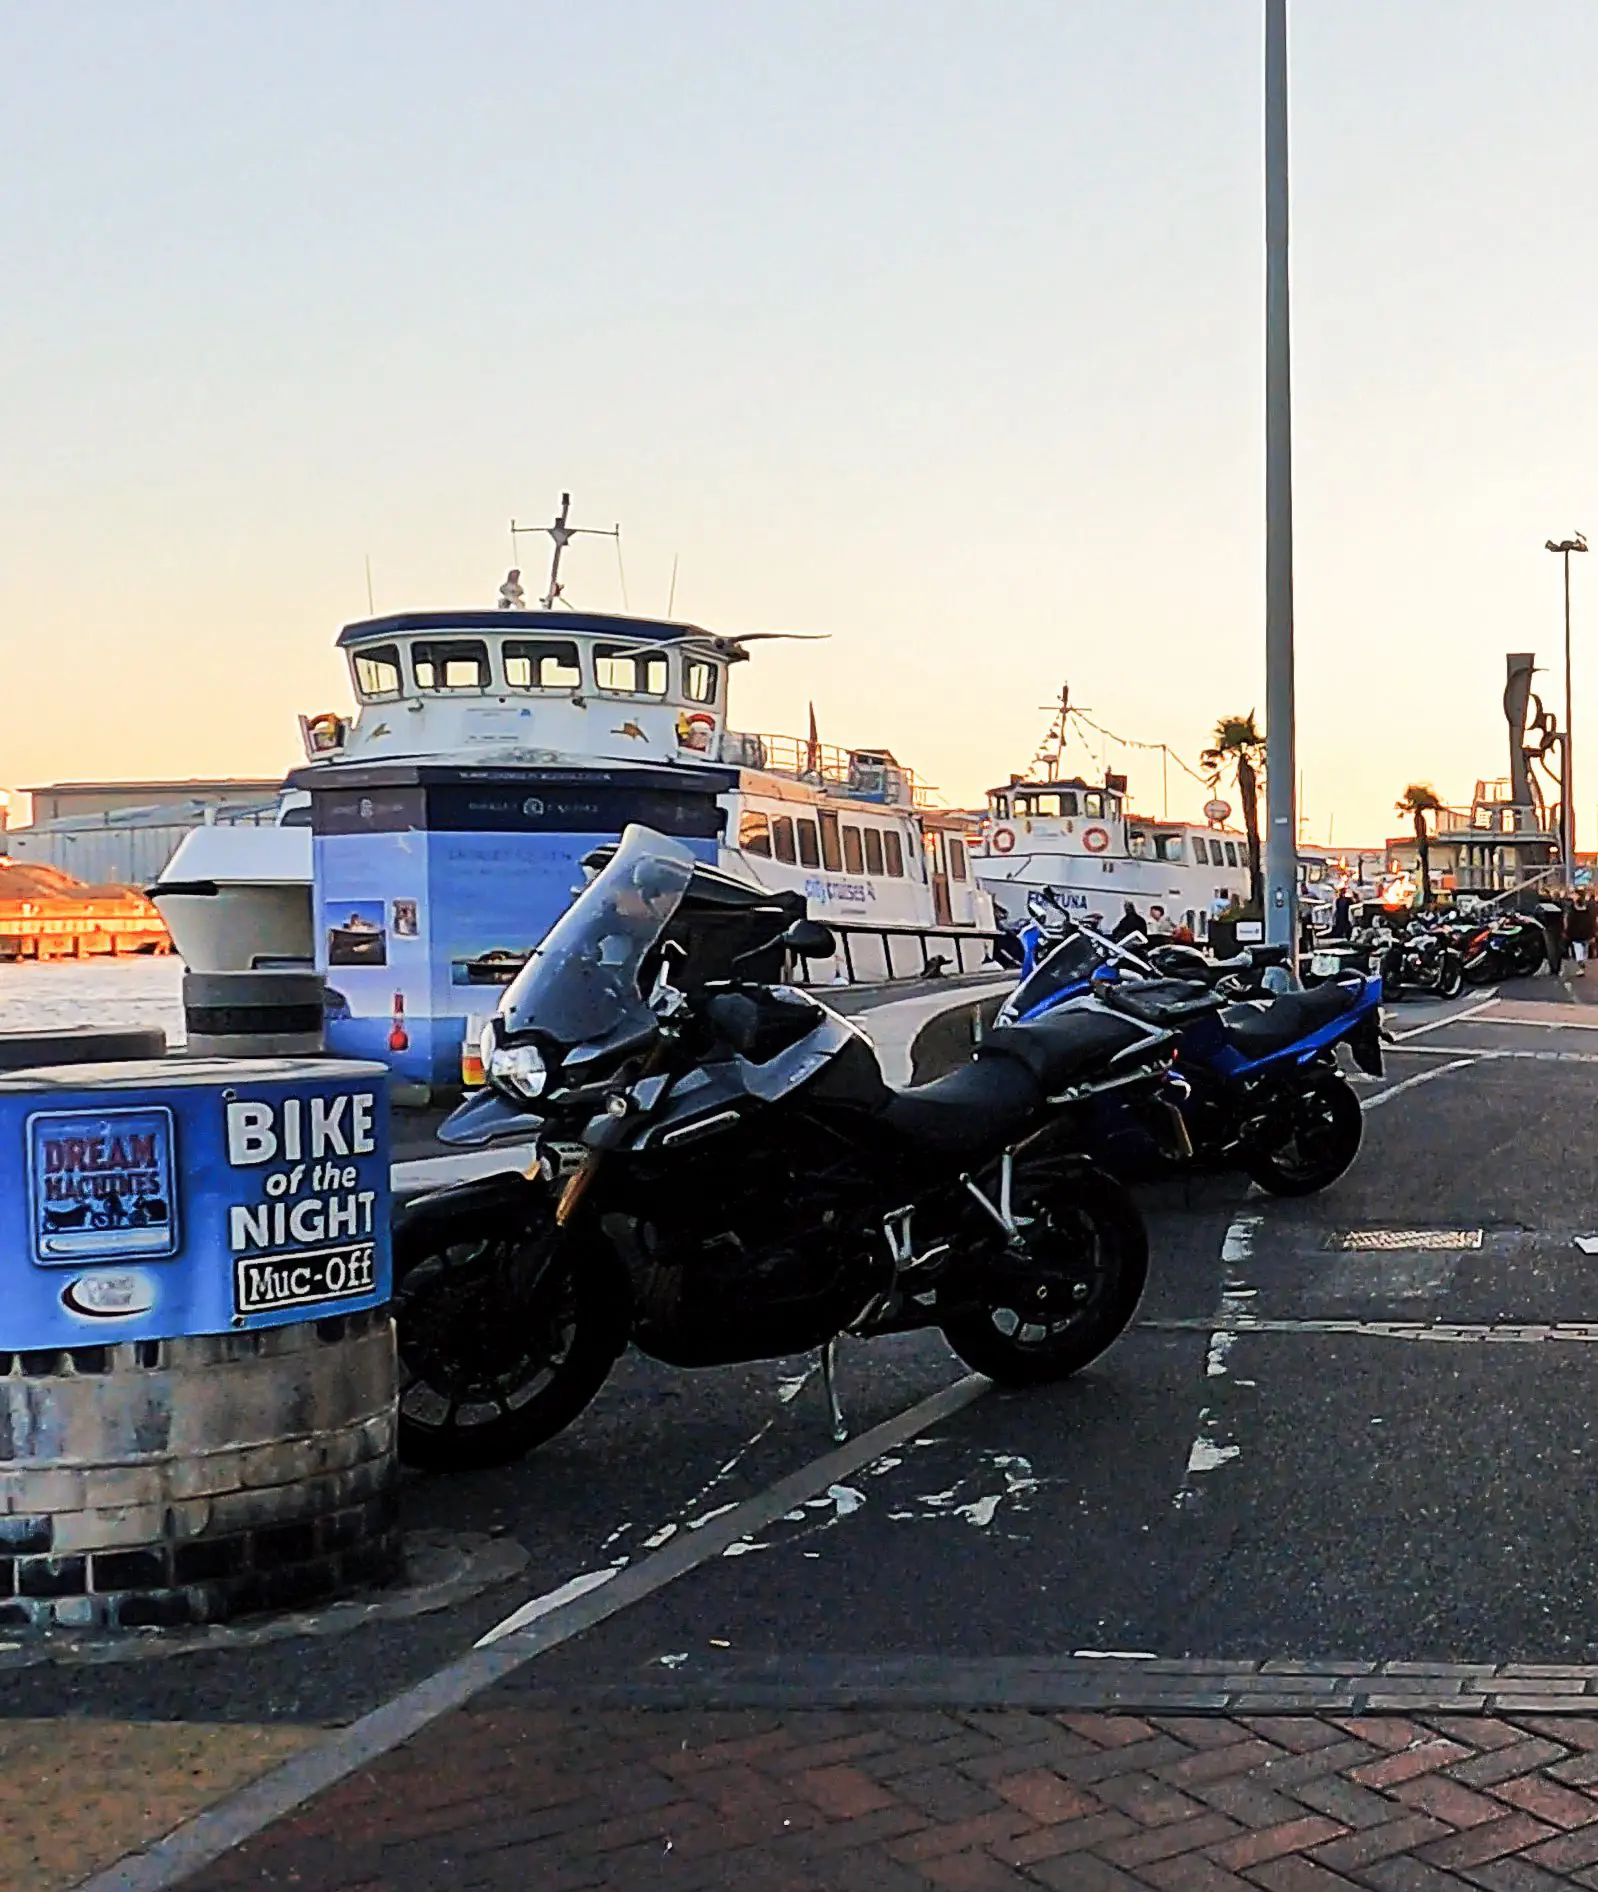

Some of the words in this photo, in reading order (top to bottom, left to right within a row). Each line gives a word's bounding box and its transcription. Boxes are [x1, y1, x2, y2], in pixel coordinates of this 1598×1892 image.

[1027, 890, 1088, 910] FOTUNA
[44, 1133, 159, 1173] DREAM
[226, 1093, 375, 1166] BIKE
[266, 1163, 306, 1197] of
[311, 1160, 357, 1190] the
[230, 1191, 375, 1251] NIGHT
[248, 1248, 373, 1303] Muc-Off
